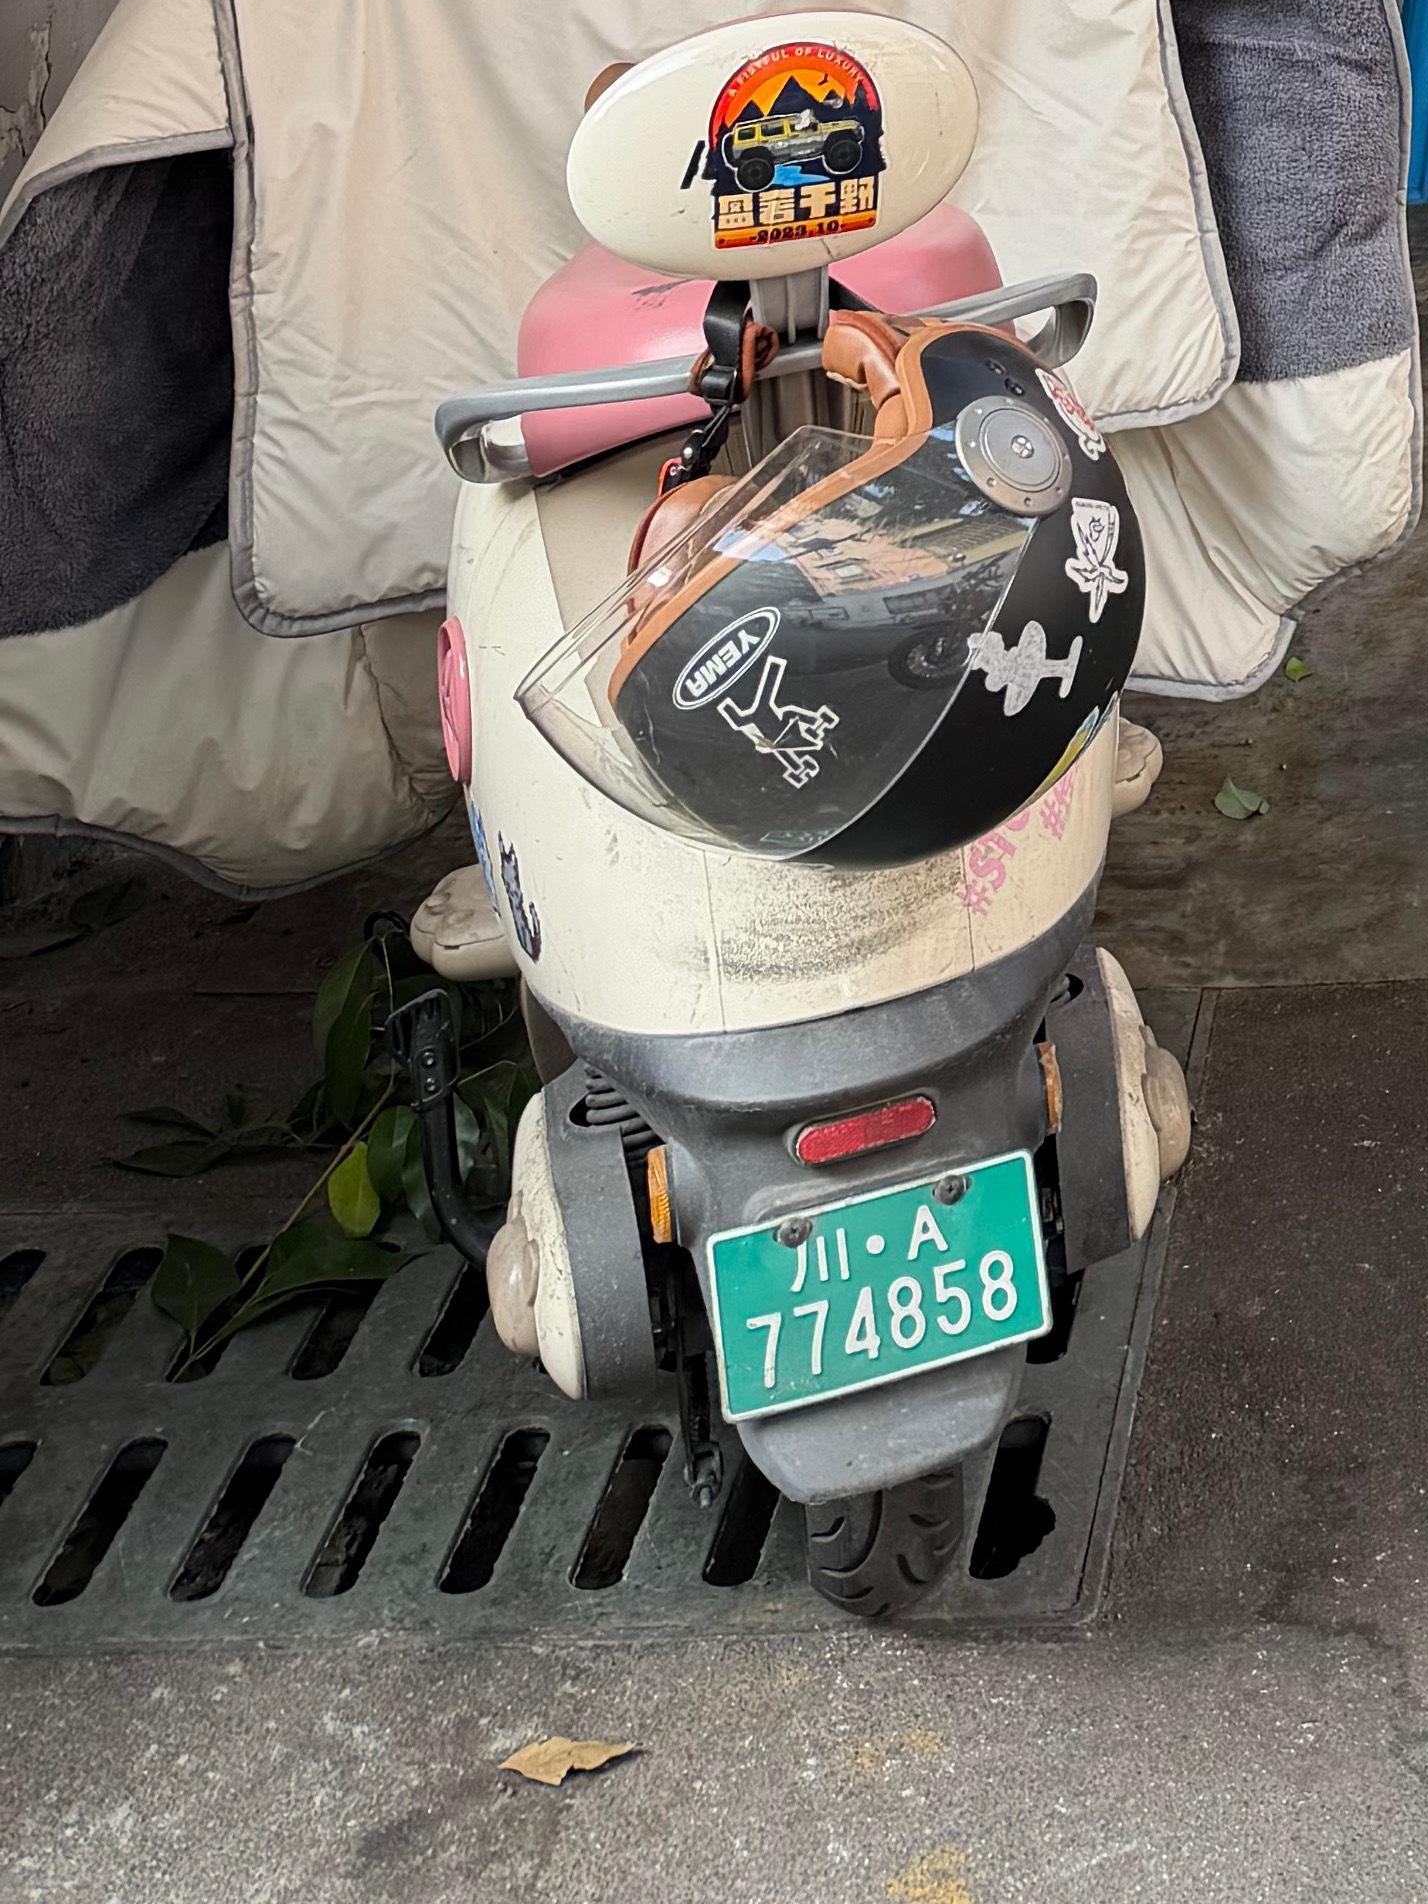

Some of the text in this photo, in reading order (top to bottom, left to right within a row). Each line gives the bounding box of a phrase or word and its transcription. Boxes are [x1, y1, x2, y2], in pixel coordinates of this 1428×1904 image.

[794, 46, 812, 58] OF
[817, 47, 865, 81] LUXURY
[746, 1249, 1018, 1389] 774858
